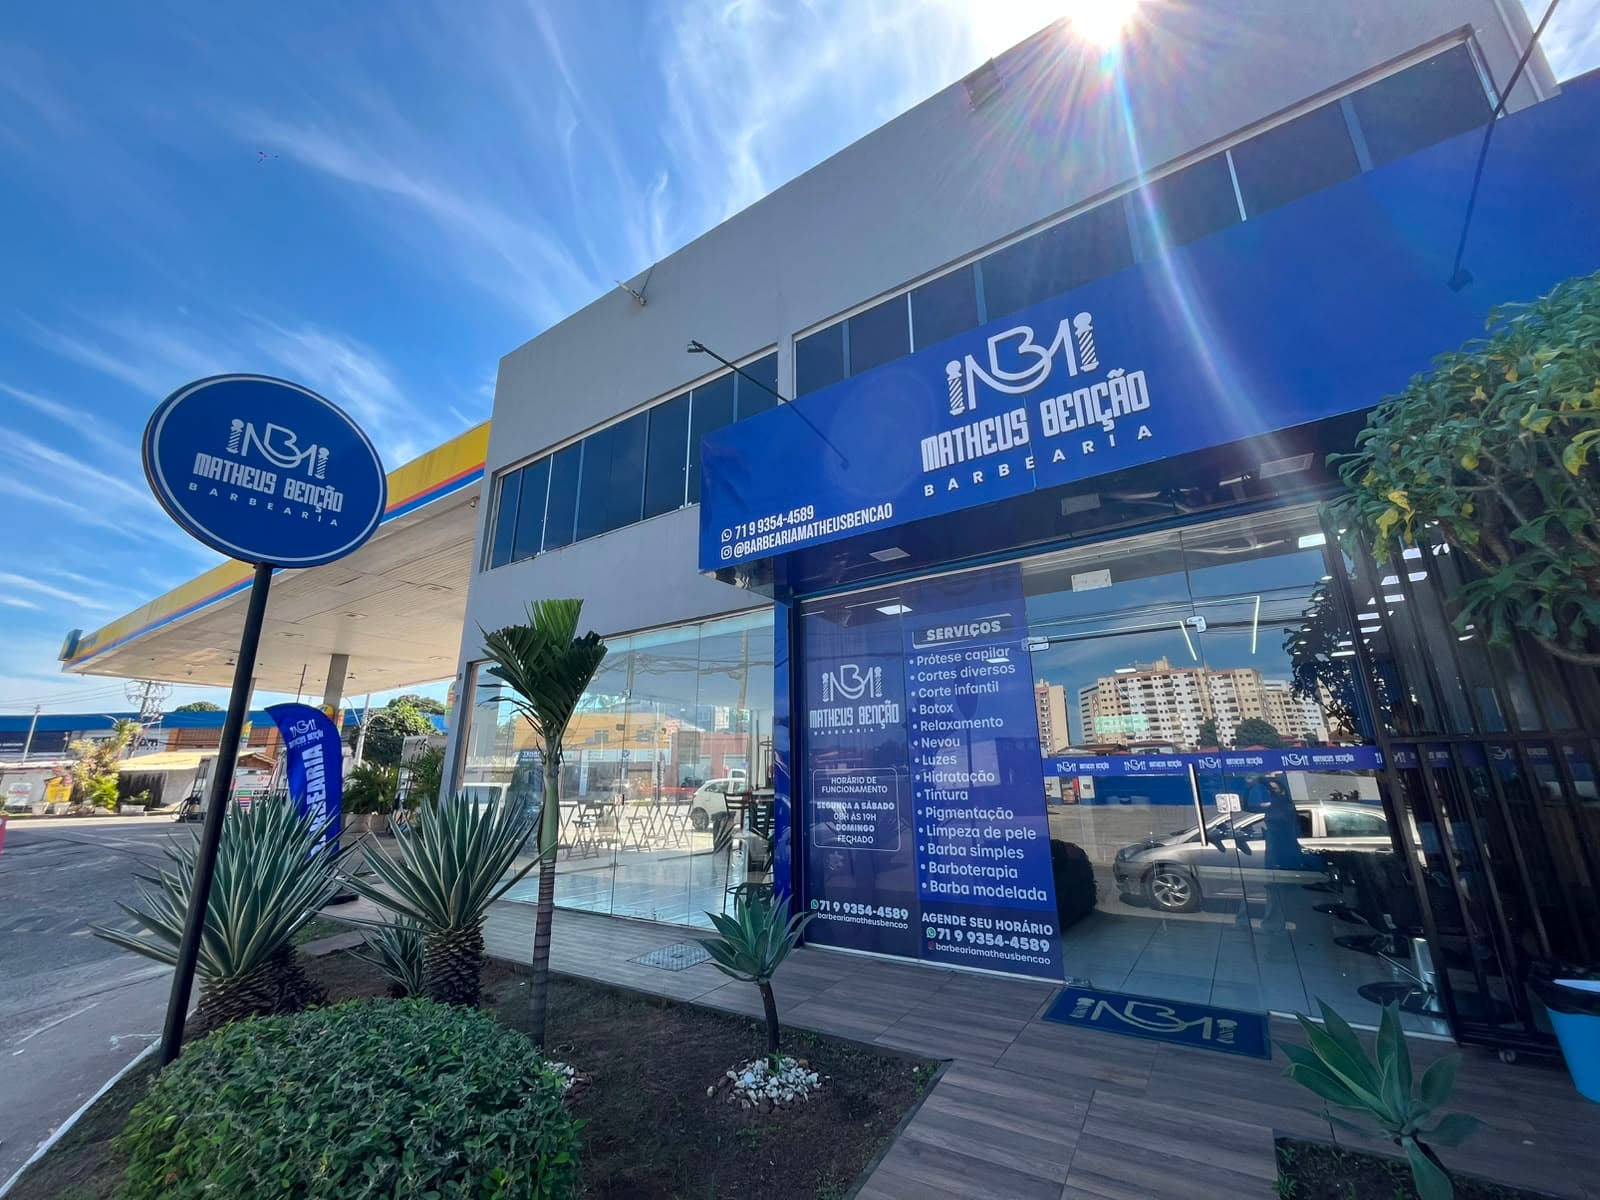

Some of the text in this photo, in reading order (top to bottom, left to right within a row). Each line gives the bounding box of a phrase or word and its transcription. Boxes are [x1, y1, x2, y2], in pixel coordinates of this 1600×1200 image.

[920, 367, 1151, 473] MATHEUS BENÇÃO
[923, 424, 1153, 497] BARBEARIA
[193, 452, 344, 513] MATHEUS BENÇÃO
[188, 482, 338, 527] BARBEARIA
[757, 504, 815, 533] 9354-4589
[733, 502, 893, 558] @BARBEARIAMATHEUSBENCAO
[926, 620, 1001, 641] SERVIÇOS
[916, 647, 1010, 666] Prótese capilar
[917, 664, 1016, 682] Cortes diversos
[918, 681, 999, 698] Corte infantil
[809, 699, 900, 729] MATHEUS BENÇÃO
[919, 703, 954, 715] Botox
[920, 717, 1004, 732] Relaxamento
[921, 737, 961, 749] Nevou
[922, 754, 958, 766] Luzes
[831, 775, 877, 784] HORÁRIO DE
[923, 770, 995, 784] Hidratação
[821, 785, 888, 793] FUNCIONAMENTO
[924, 788, 969, 800] Tintura
[853, 802, 860, 810] A
[861, 800, 895, 810] SÁBADO
[925, 806, 1014, 821] Pigmentação
[862, 813, 877, 821] 19H
[835, 823, 875, 833] DOMINGO
[926, 824, 1037, 842] Limpeza de pele
[837, 834, 874, 844] FECHADO
[927, 843, 1025, 861] Barba simples
[928, 861, 1018, 880] Barboterapia
[930, 880, 1048, 901] Barba modelada
[819, 900, 909, 920] 71 9 9354-4589
[817, 912, 908, 929] barbeariamatheusbencao
[921, 912, 1054, 936] AGENDE SEU HORÁRIO
[937, 928, 1050, 953] 71 9 9354-4589
[935, 941, 1051, 965] barbeariamatheusbencao
